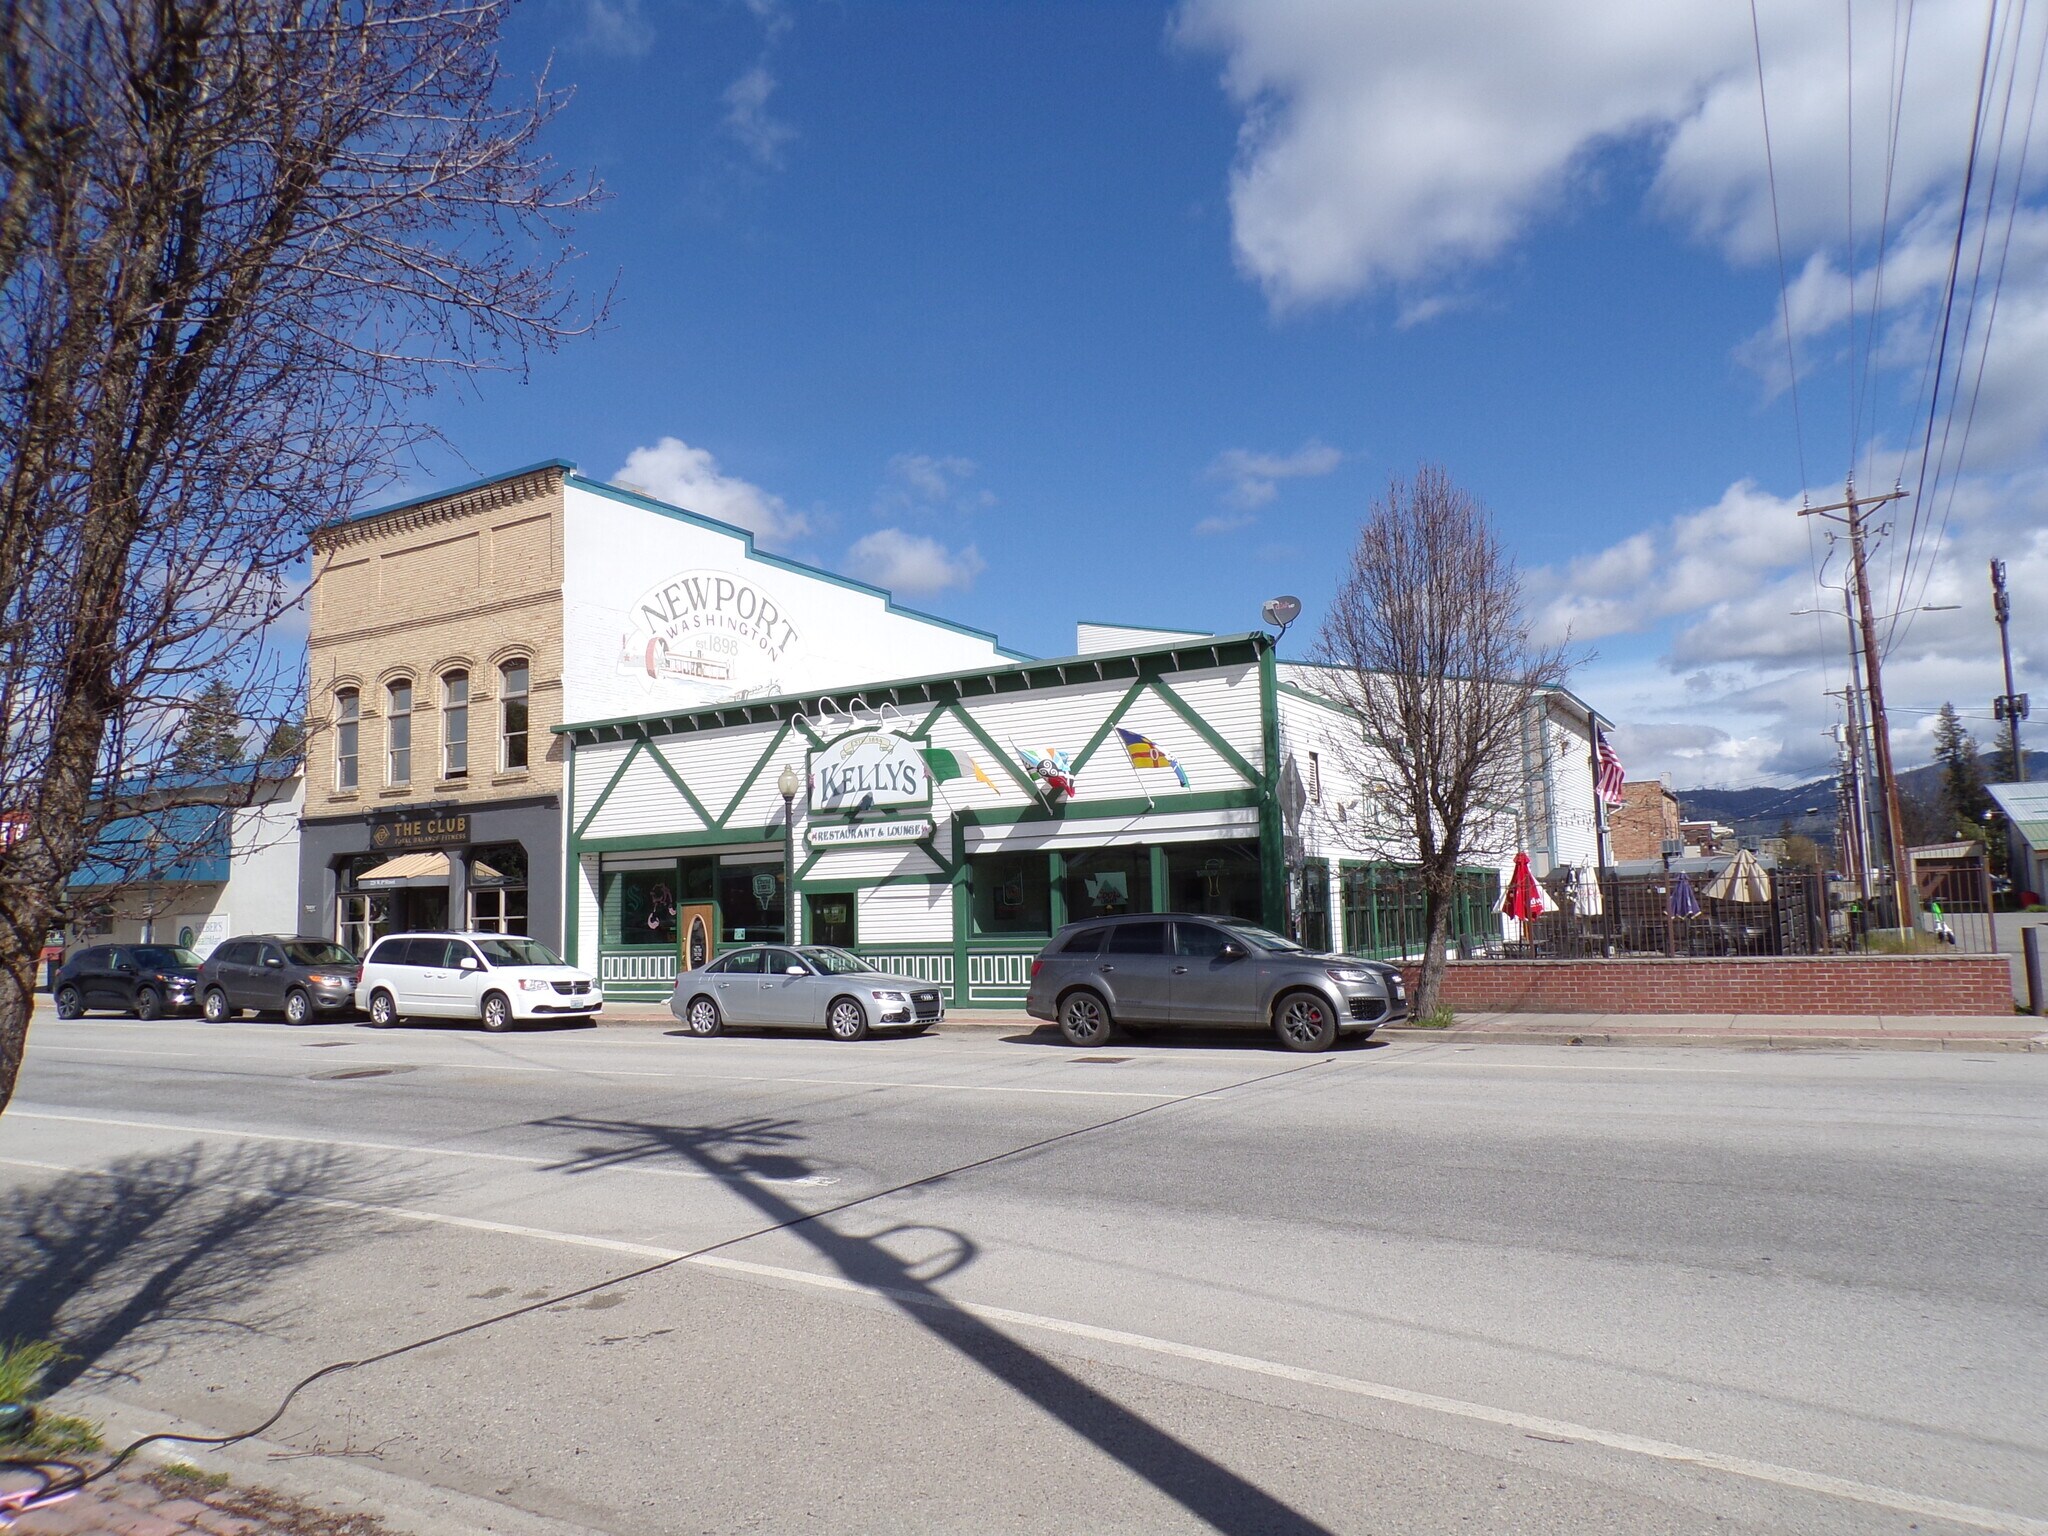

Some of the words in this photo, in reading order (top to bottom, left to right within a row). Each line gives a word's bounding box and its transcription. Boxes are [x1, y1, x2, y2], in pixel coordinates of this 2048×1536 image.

[641, 577, 798, 654] NEWPORT
[666, 613, 778, 662] WASHINGTON
[709, 635, 739, 656] 1898
[395, 822, 421, 837] THE
[427, 817, 466, 834] CLUB
[817, 827, 876, 841] RESTAURANT
[877, 828, 884, 838] &
[887, 824, 921, 836] LOUNGE
[395, 838, 411, 846] TOTAL
[441, 833, 467, 841] FITNESS
